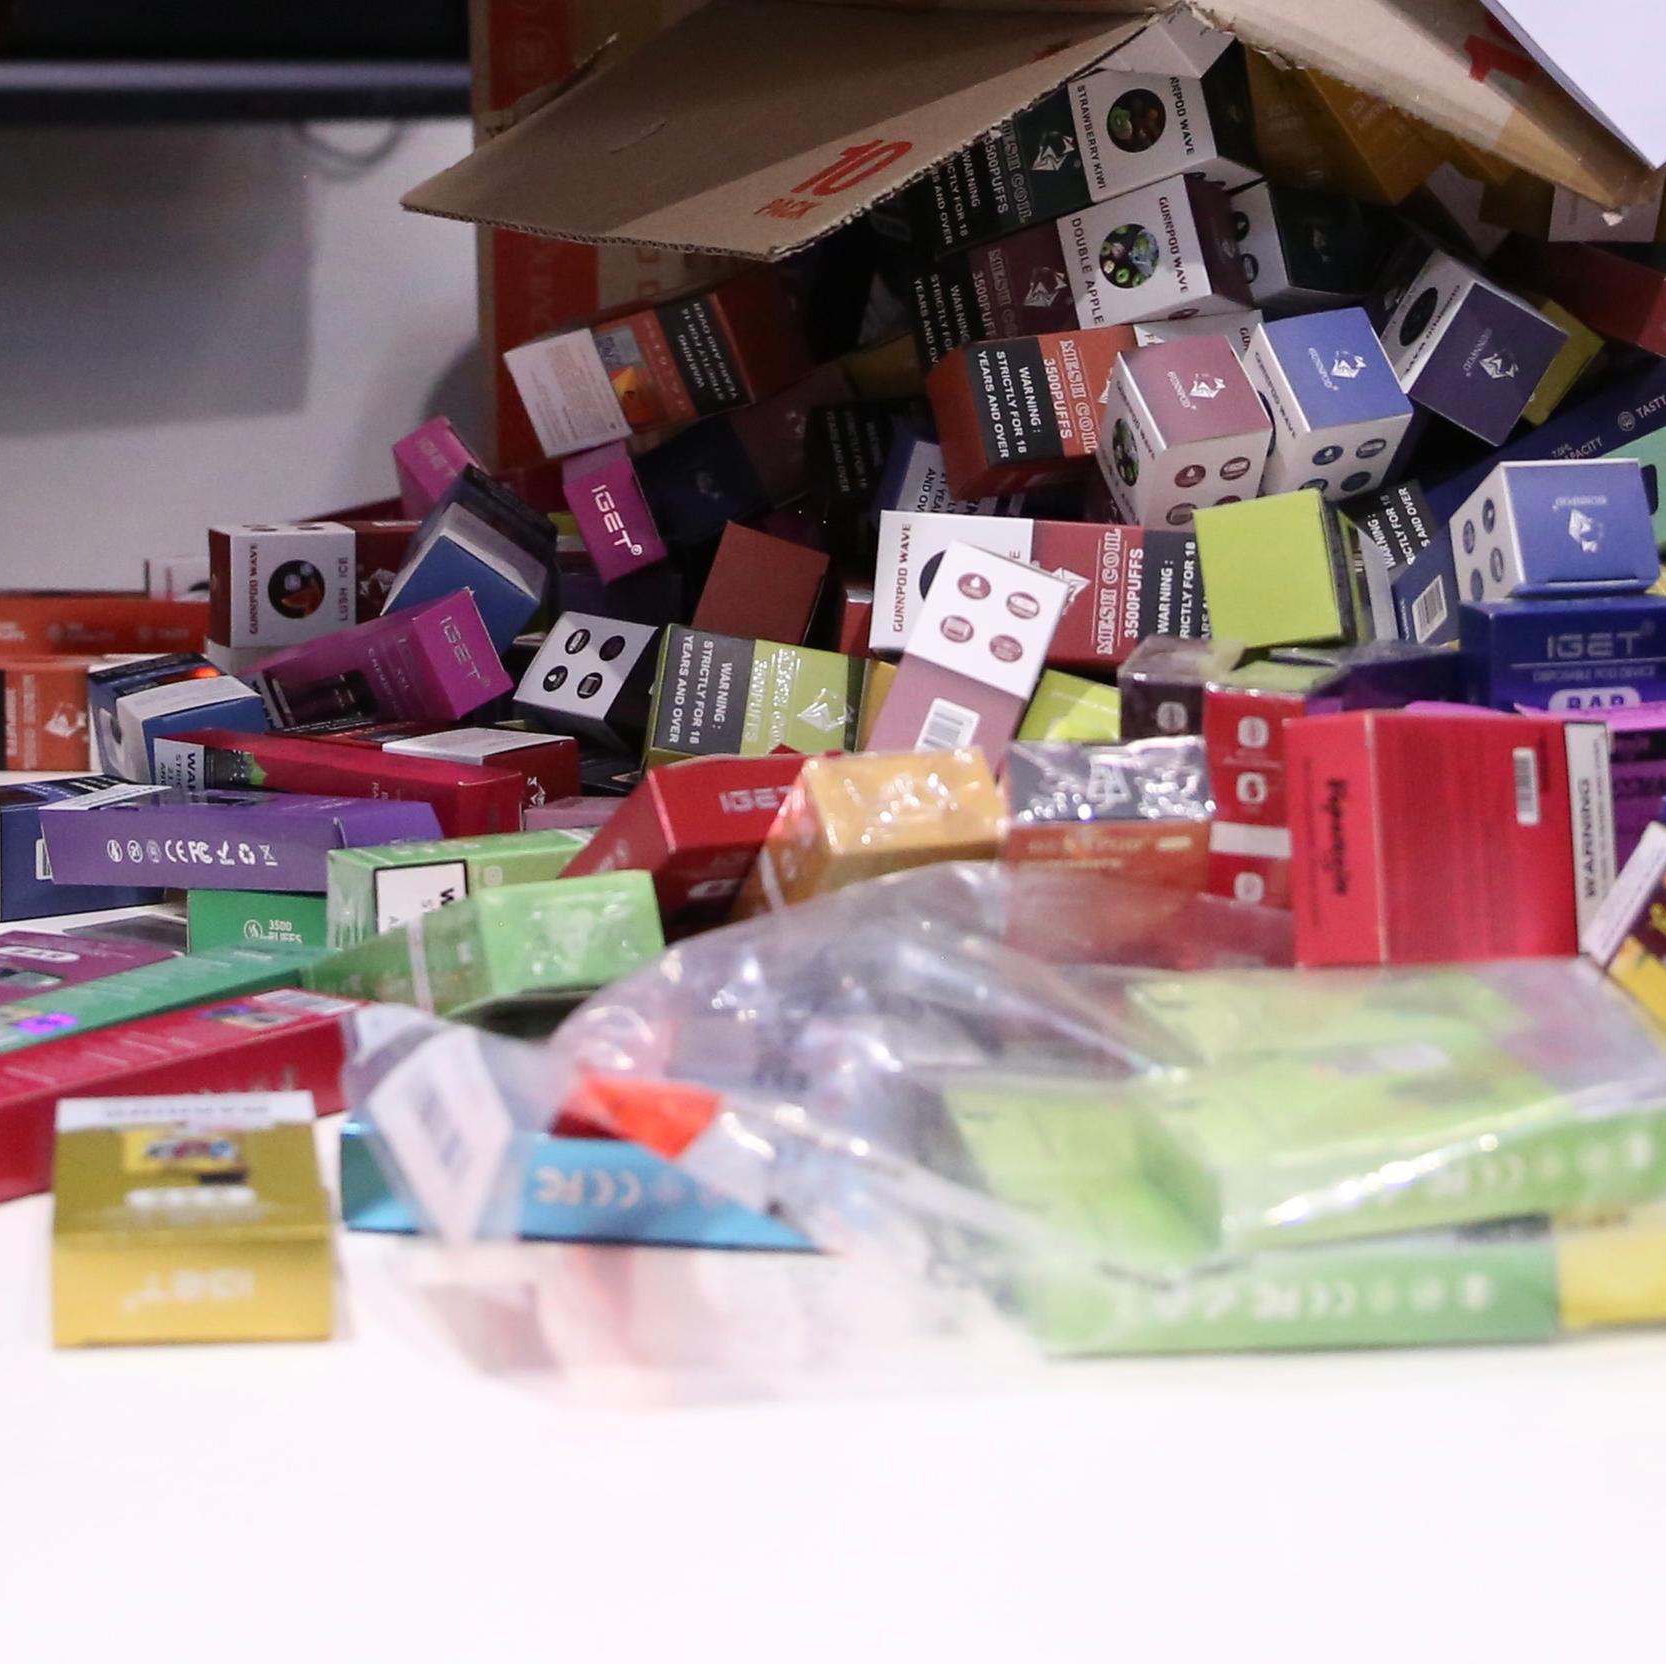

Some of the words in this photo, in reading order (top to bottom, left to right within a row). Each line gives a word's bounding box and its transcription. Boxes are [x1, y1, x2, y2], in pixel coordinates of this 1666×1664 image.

[1180, 118, 1195, 156] WAVE
[791, 139, 913, 197] 10
[1094, 163, 1106, 189] KIWI
[1072, 217, 1092, 274] DOUBLE
[1085, 280, 1105, 325] APPLE
[1173, 259, 1189, 293] WAVE
[996, 350, 1018, 409] STRICTLY
[1019, 366, 1042, 427] WARNING
[978, 350, 995, 393] YEARS
[987, 394, 1001, 422] AND
[994, 422, 1009, 459] OVER
[1043, 358, 1073, 439] 3500PUFFS
[1010, 410, 1024, 438] FOR
[1016, 440, 1027, 454] 18
[592, 484, 635, 549] IGET
[1385, 506, 1402, 529] FOR
[1398, 487, 1418, 517] OVER
[899, 523, 911, 564] WAVE
[1410, 517, 1428, 538] AND
[249, 541, 259, 575] WAVE
[338, 555, 349, 579] ICE
[1185, 541, 1196, 556] 18
[1124, 548, 1144, 639] 3500PUFFS
[1182, 560, 1195, 590] FOR
[248, 575, 259, 636] GUNNPOD
[338, 586, 349, 622] LUSH
[892, 567, 909, 633] GUNNPOD
[1157, 567, 1173, 635] WARNING
[679, 635, 694, 677] YEARS
[1547, 633, 1639, 662] IGET
[696, 640, 714, 702] STRICTLY
[674, 678, 688, 703] AND
[714, 662, 733, 724] WARNING
[669, 706, 684, 744] OVER
[692, 700, 706, 728] FOR
[689, 731, 700, 745] 18
[268, 919, 293, 932] 3500
